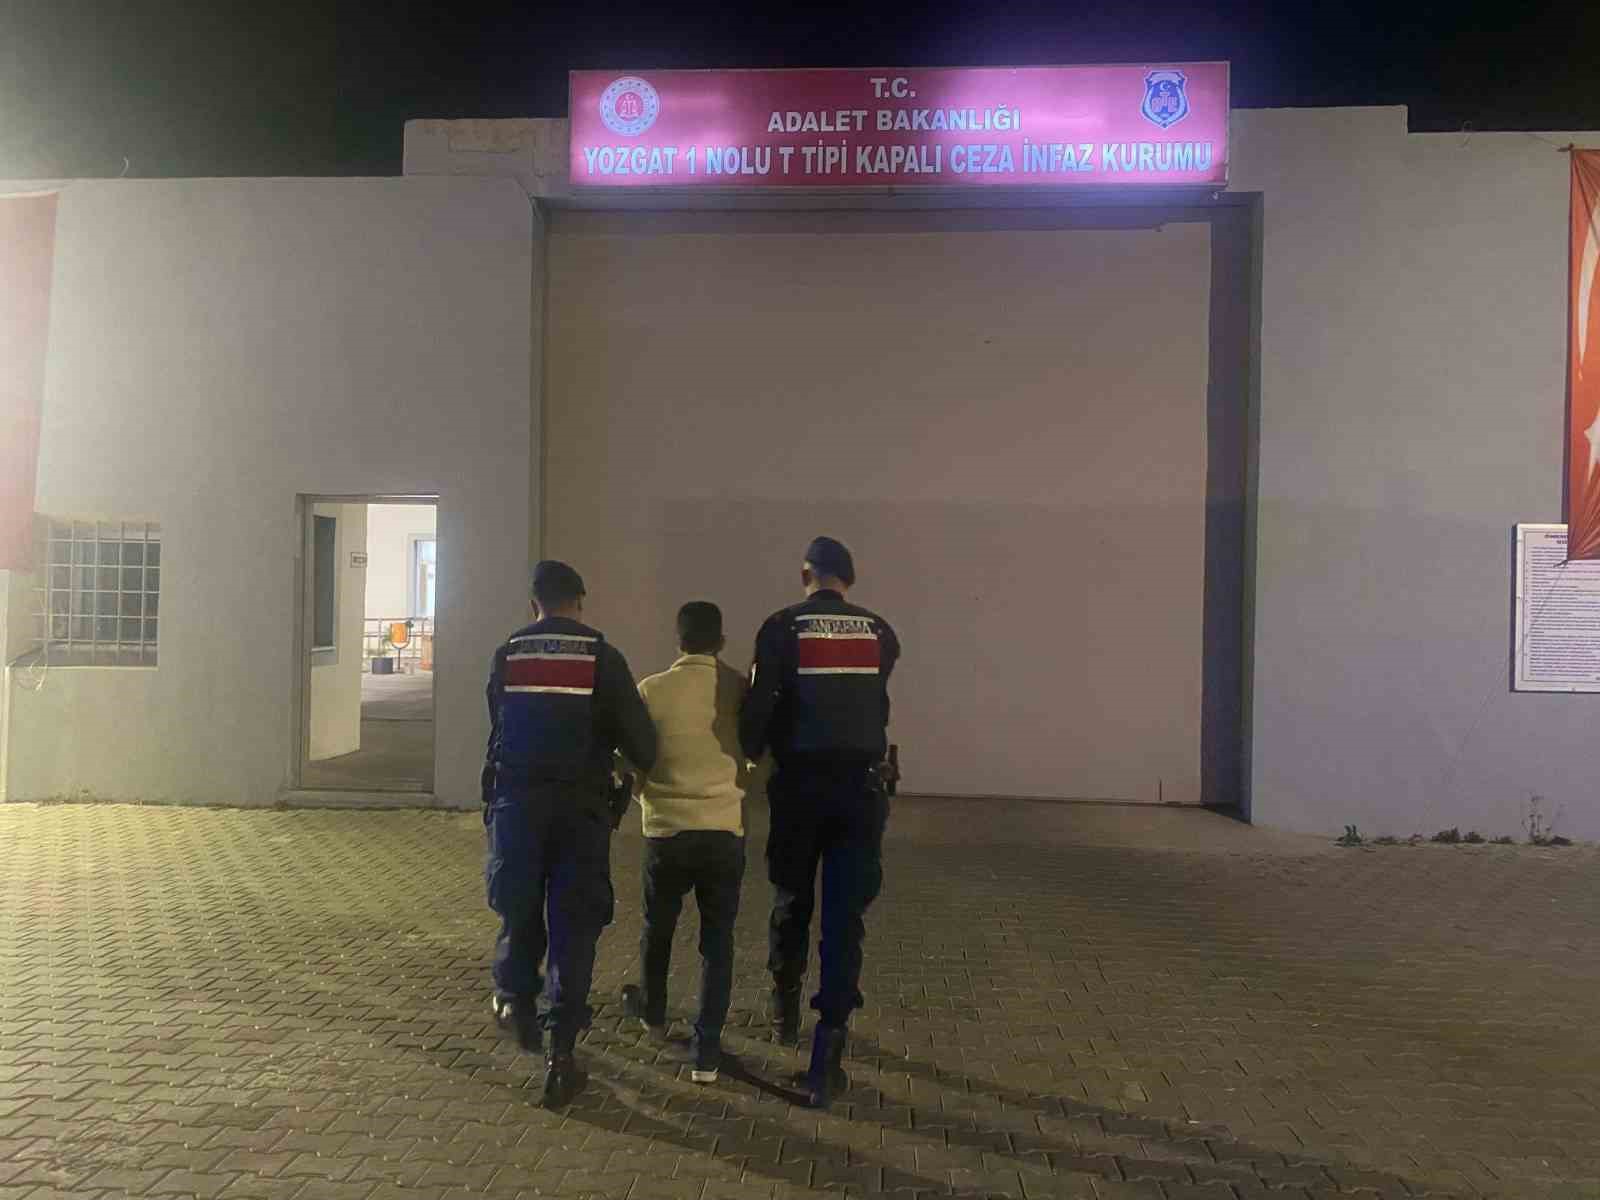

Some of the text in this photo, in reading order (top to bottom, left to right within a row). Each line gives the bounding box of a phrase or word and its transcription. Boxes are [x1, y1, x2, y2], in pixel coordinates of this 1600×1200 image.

[871, 78, 916, 98] T.C.
[768, 104, 1021, 132] ADALET BAKANLIĞI
[583, 138, 1212, 175] YOZGAT 1 NOLU T TİPİ KAPALI CEZA İNFAZ KURUMU
